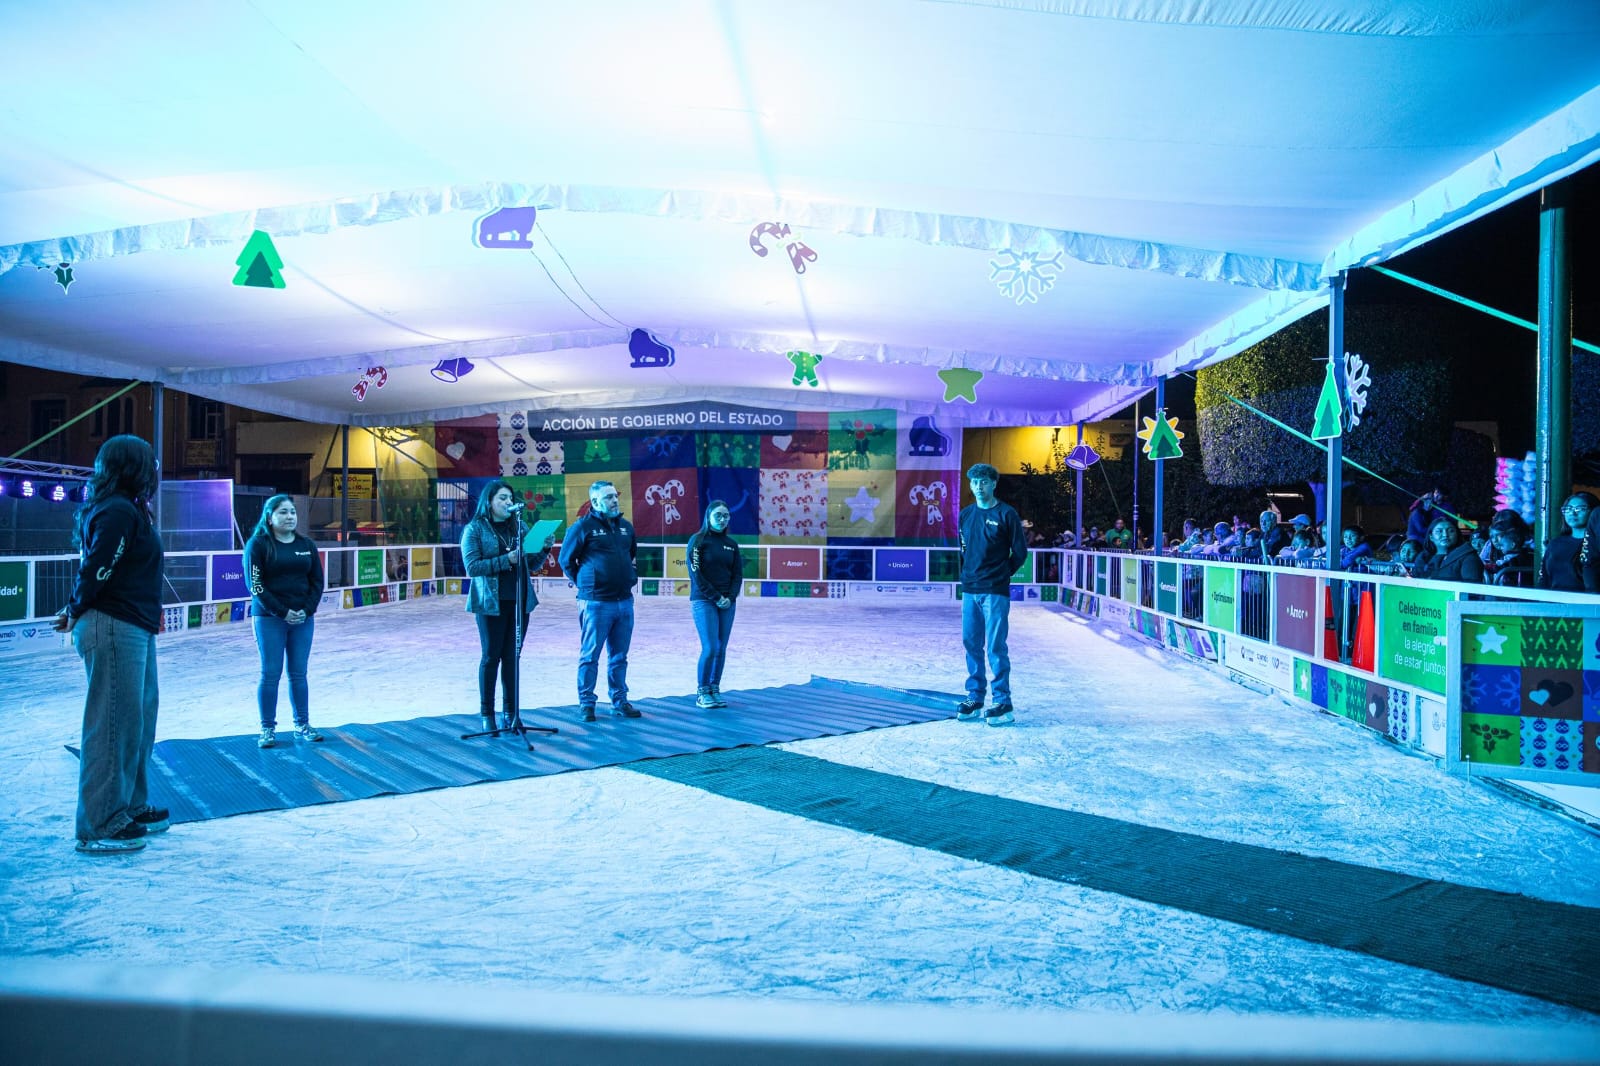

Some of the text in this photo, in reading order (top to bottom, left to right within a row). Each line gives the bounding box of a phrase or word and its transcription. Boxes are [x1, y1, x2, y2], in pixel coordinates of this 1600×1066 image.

[542, 411, 783, 432] ACCIÓN DE GOBIERNO DEL ESTADO
[892, 561, 910, 569] Unión
[225, 571, 240, 581] Unión
[1213, 591, 1233, 604] Optimismo
[1289, 604, 1305, 620] Amor
[1398, 600, 1442, 620] Celebremos
[1402, 620, 1438, 637] en familia
[1404, 635, 1411, 650] la
[1394, 651, 1446, 676] de estar juntos
